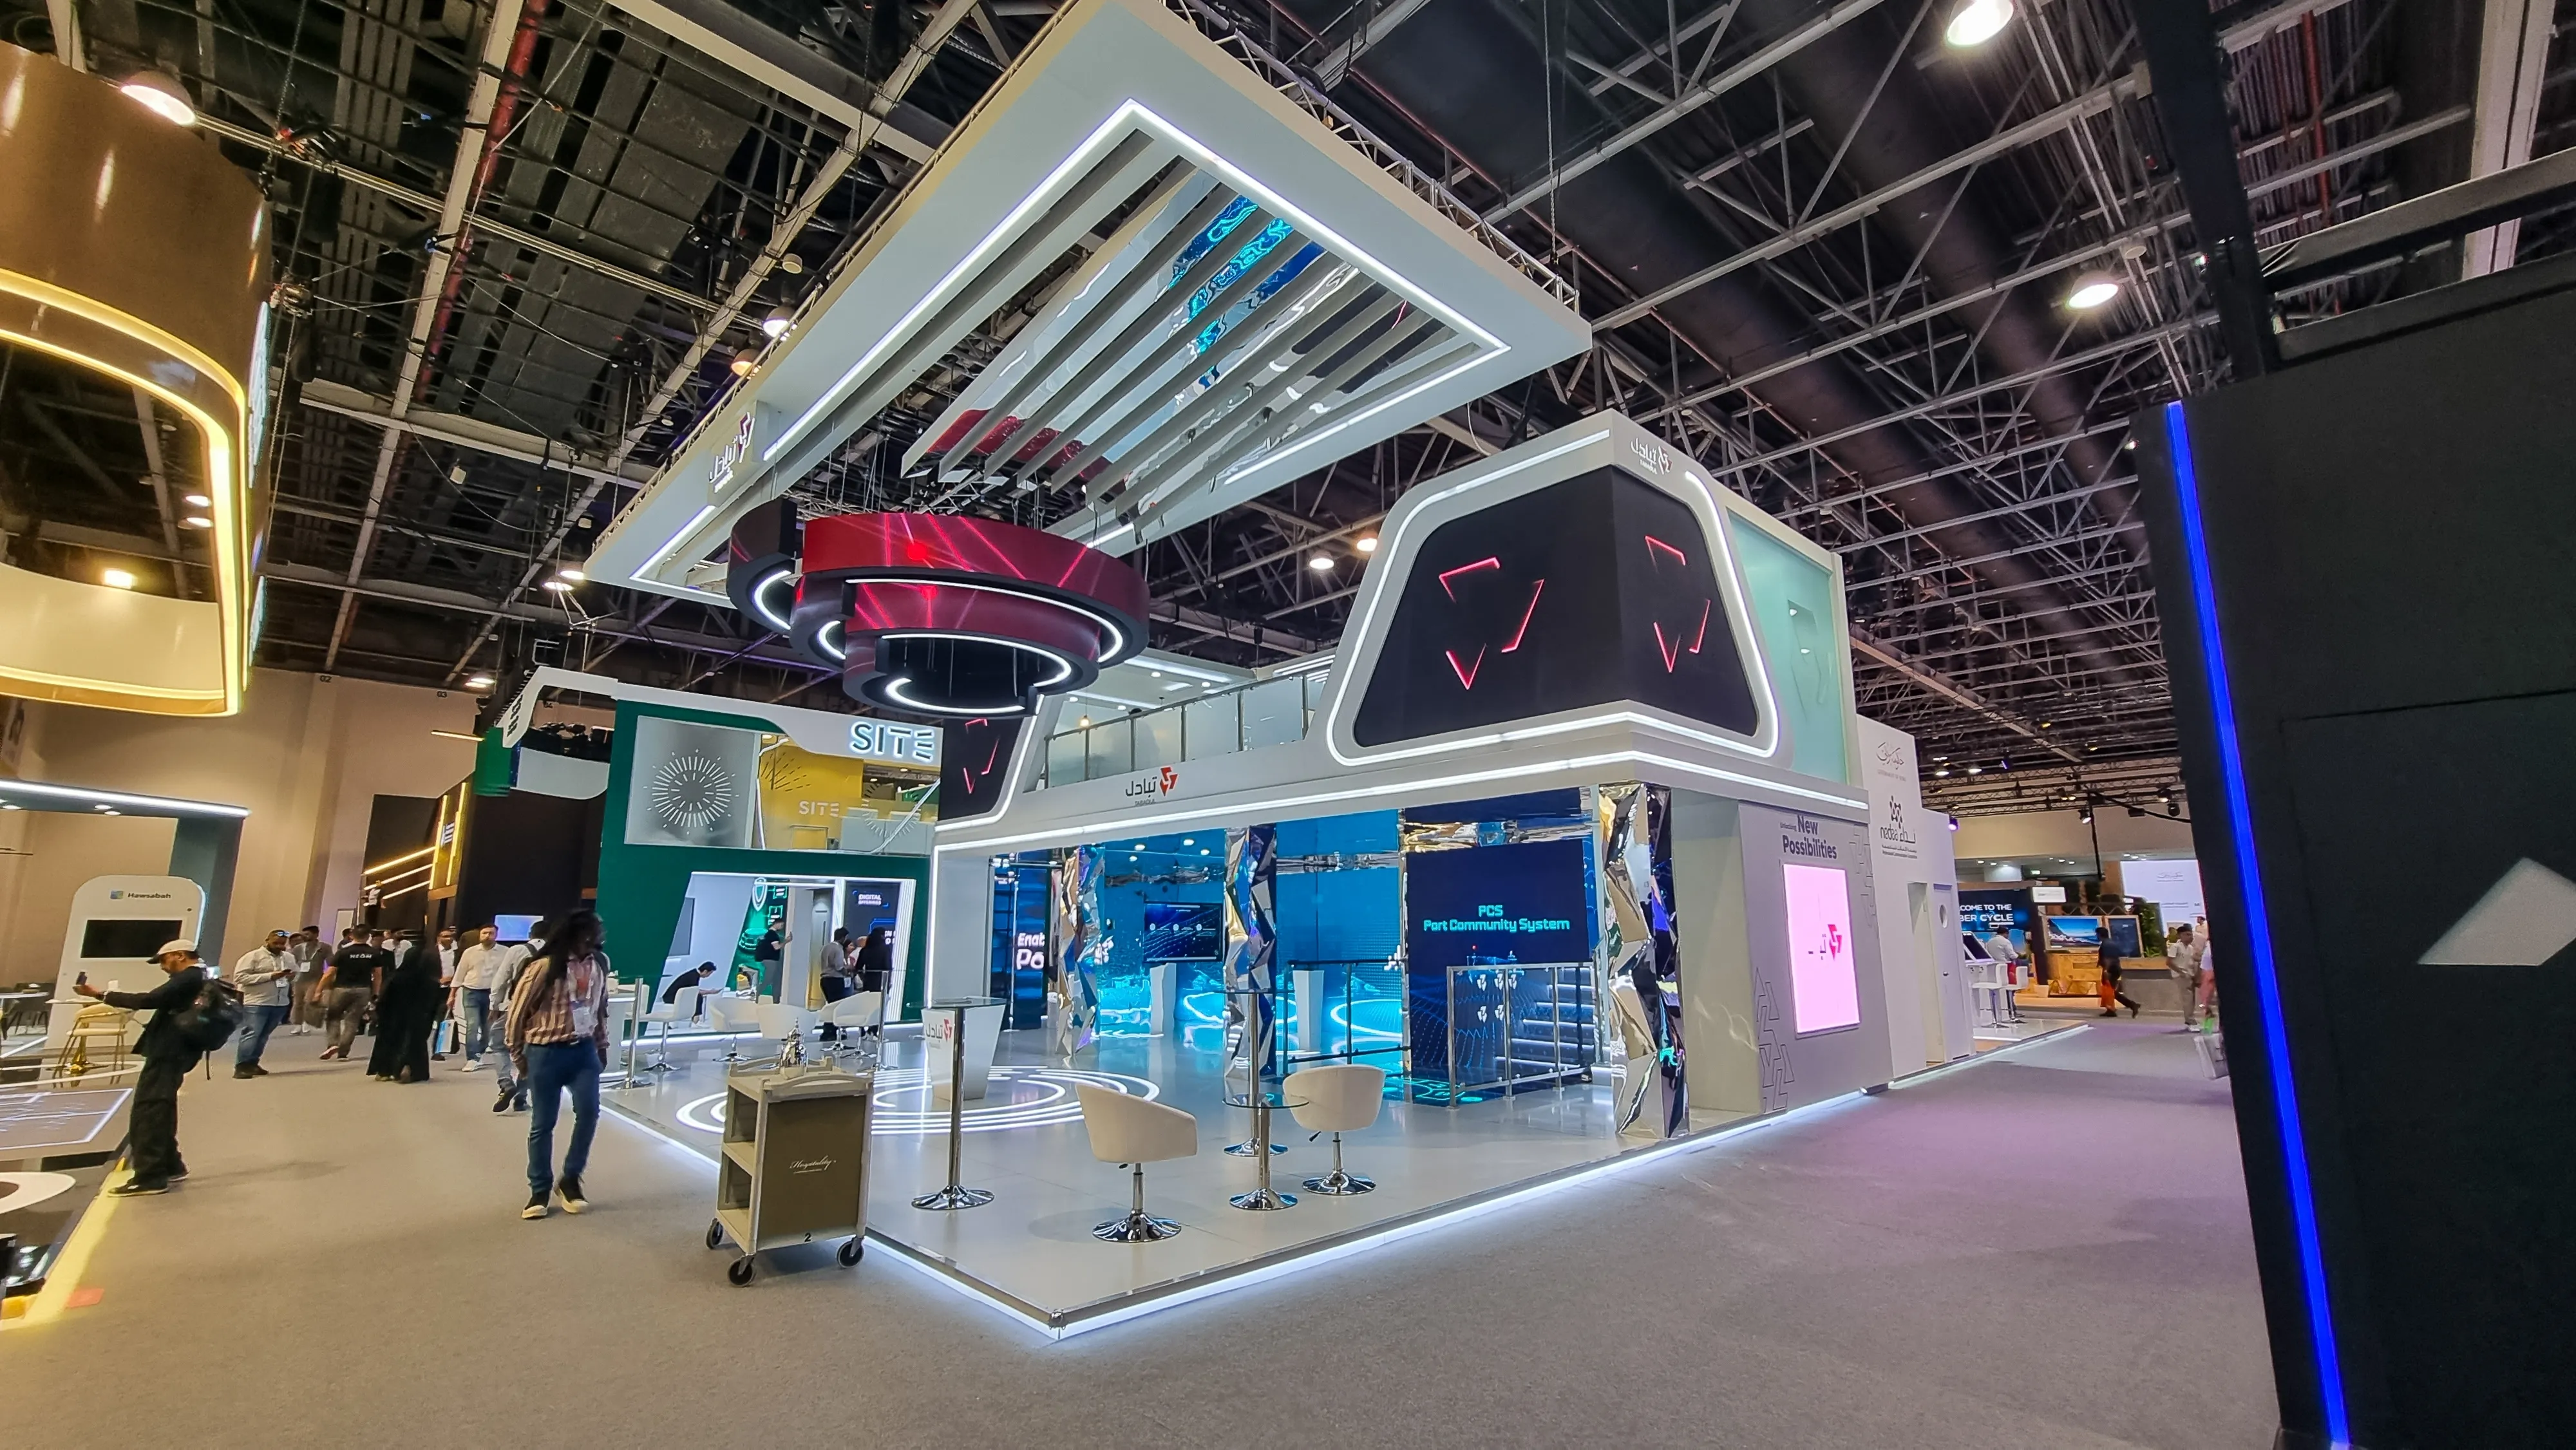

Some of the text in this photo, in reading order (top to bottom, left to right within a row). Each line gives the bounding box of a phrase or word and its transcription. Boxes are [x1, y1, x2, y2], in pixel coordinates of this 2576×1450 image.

[1631, 438, 1656, 465] تبادل
[851, 722, 934, 762] SITE
[1125, 777, 1157, 797] تبادل
[799, 800, 839, 818] SITE
[1797, 814, 1818, 835] New
[1782, 834, 1837, 859] Possibilities
[1478, 905, 1503, 917] PCS
[1424, 918, 1570, 932] Port Community System
[926, 1023, 943, 1043] تبادل
[804, 1232, 811, 1243] 2
